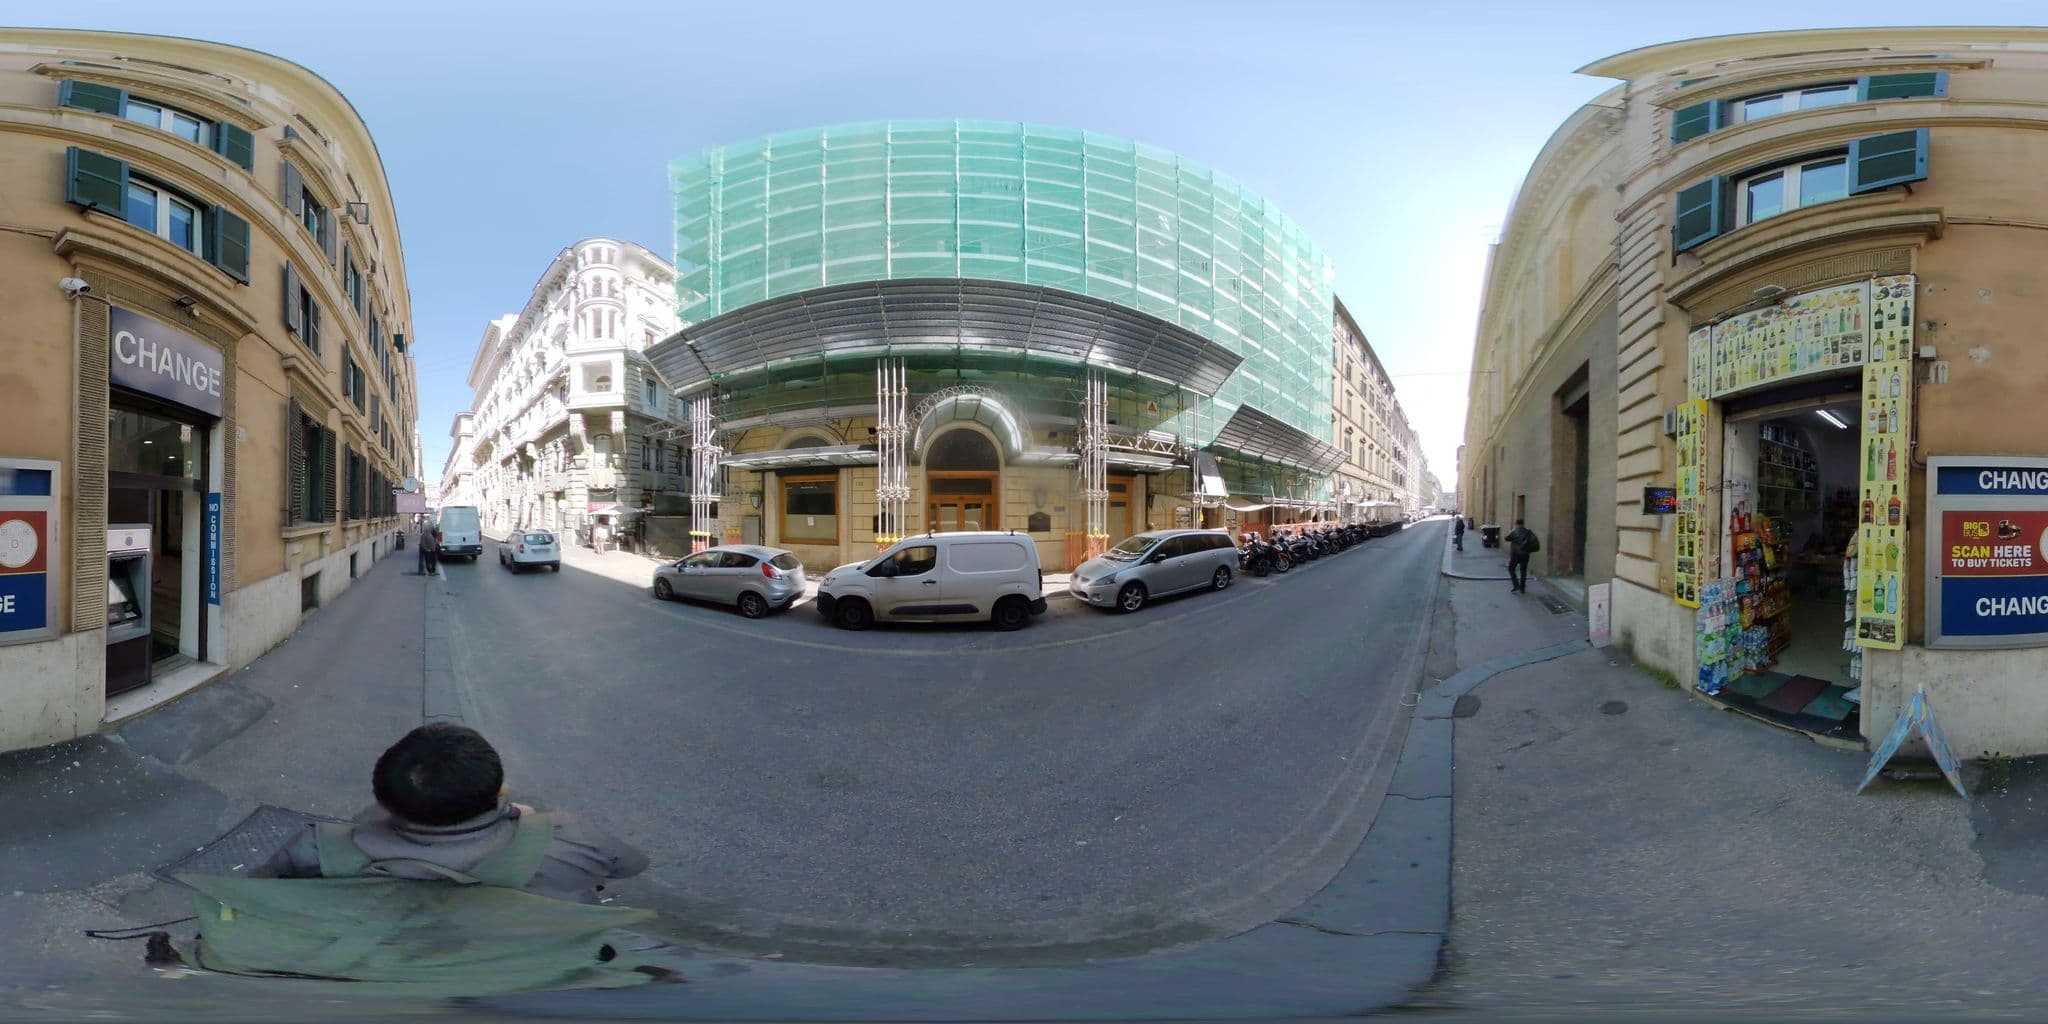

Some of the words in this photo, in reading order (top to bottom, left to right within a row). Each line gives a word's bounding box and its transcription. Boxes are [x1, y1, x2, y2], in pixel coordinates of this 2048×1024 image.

[115, 330, 221, 398] CHANGE
[209, 503, 219, 512] NO
[1963, 521, 1978, 530] BIG
[1952, 545, 1990, 558] SCAN
[1994, 545, 2032, 557] HERE
[1952, 558, 1965, 568] TO
[1967, 558, 1987, 567] BUY
[1990, 558, 2032, 568] TICKETS
